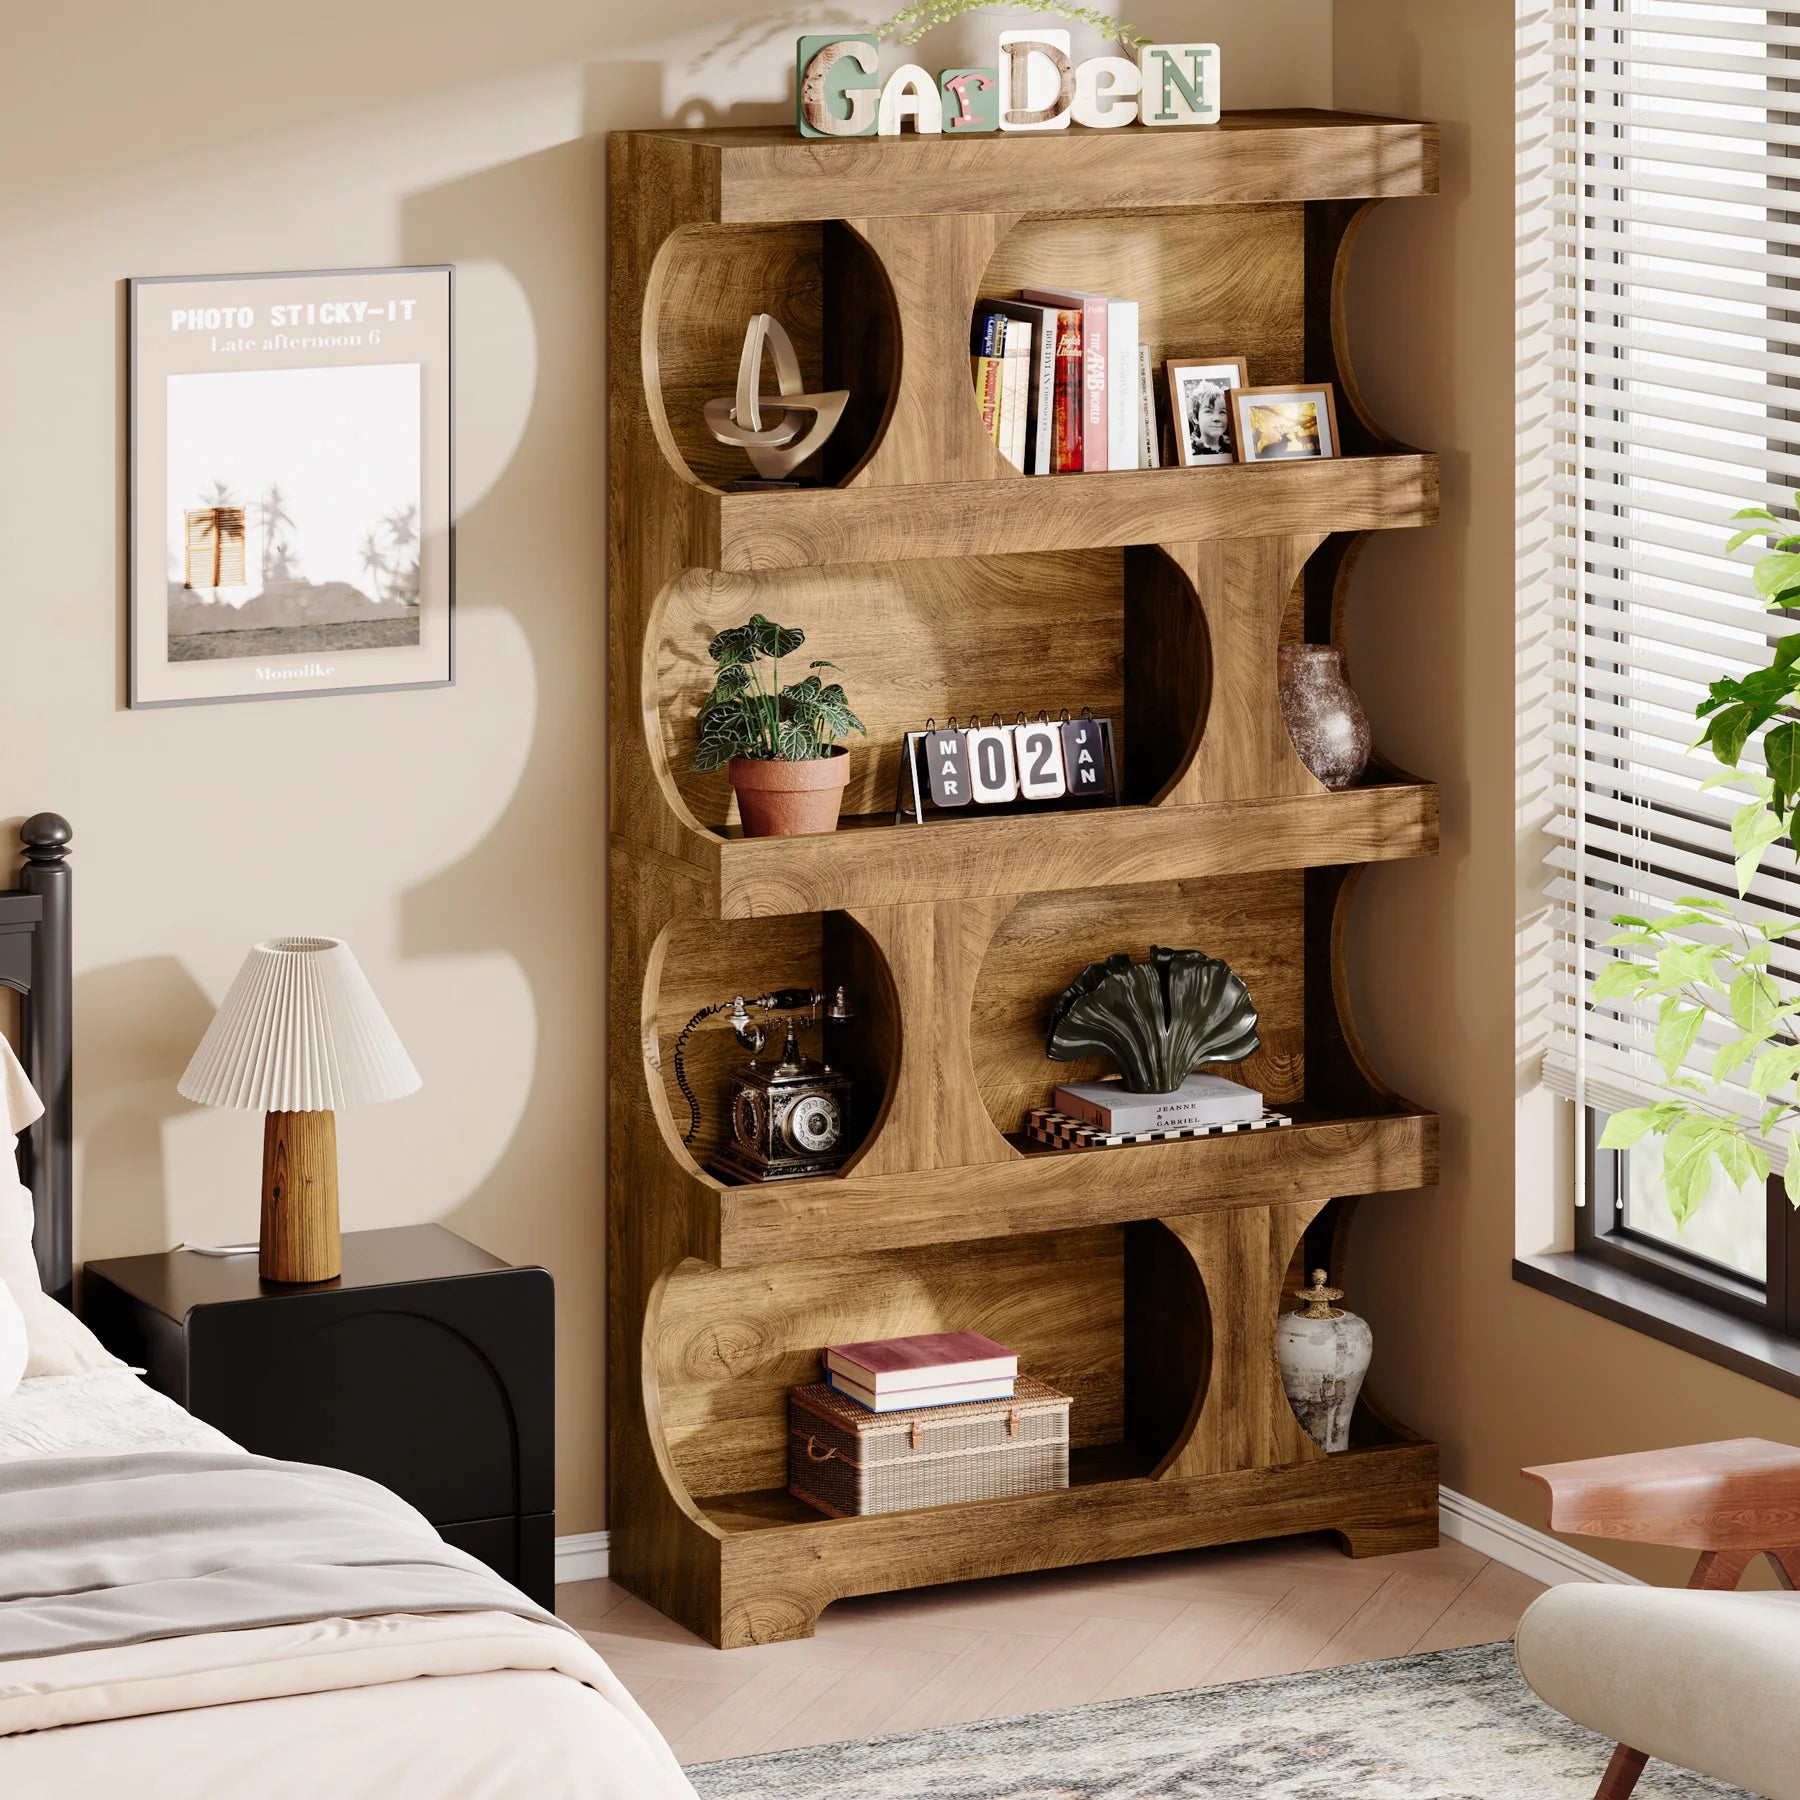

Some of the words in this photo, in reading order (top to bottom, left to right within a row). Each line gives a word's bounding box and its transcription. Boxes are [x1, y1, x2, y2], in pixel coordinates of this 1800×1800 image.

[171, 307, 254, 331] PHOTO
[270, 300, 416, 327] STICKY-IT
[211, 336, 257, 352] Late
[263, 333, 361, 351] afternoon
[368, 329, 381, 345] 6
[984, 361, 999, 404] Crossword
[1043, 352, 1052, 384] DYLAN
[1087, 348, 1105, 391] ARAB
[1090, 391, 1101, 424] WORLD
[256, 664, 336, 680] Monolike
[940, 740, 958, 795] MAR
[1075, 729, 1096, 784] JAN
[1156, 1103, 1197, 1113] JEANNE
[1156, 1117, 1200, 1127] GABRIEL
